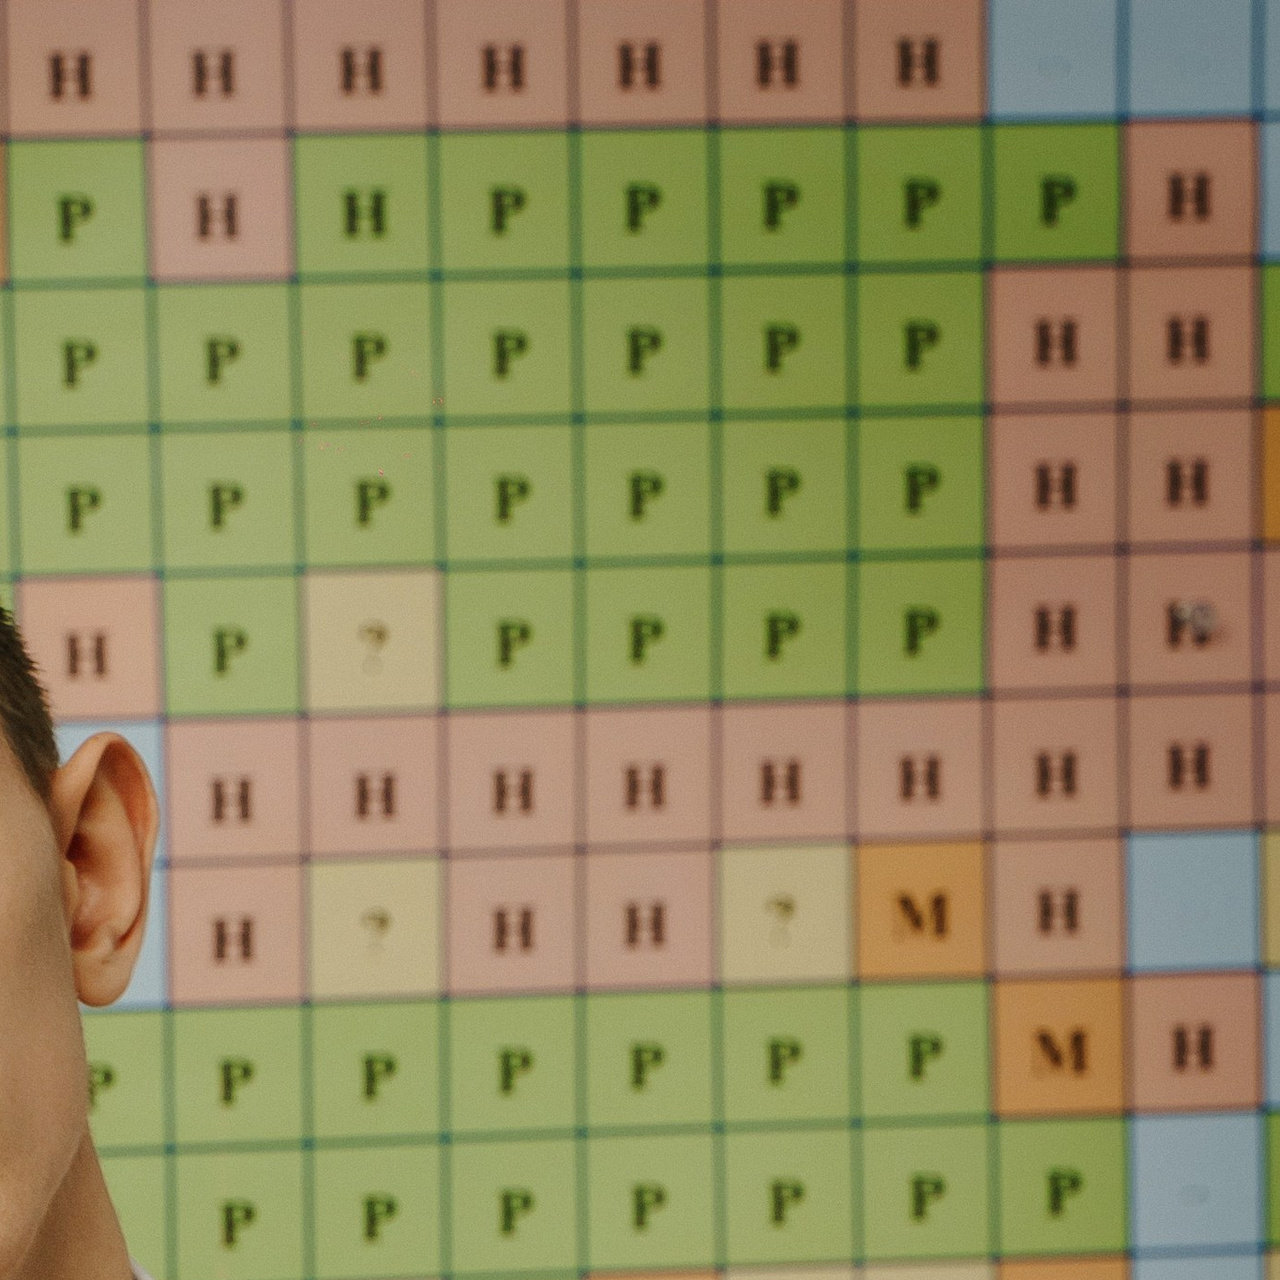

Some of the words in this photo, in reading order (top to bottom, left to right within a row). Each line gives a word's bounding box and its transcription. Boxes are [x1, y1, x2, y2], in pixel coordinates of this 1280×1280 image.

[48, 51, 92, 101] Н
[191, 49, 235, 98] Н
[339, 46, 384, 95] Н
[481, 43, 526, 94] Н
[617, 40, 662, 92] Н
[754, 38, 800, 90] Н
[895, 36, 941, 88] Н
[196, 193, 239, 241] Н
[342, 189, 387, 239] Н
[489, 186, 527, 236] Р
[624, 182, 663, 234] Р
[762, 180, 801, 233] Р
[1039, 175, 1078, 228] Р
[1167, 171, 1212, 223] Н
[62, 340, 98, 388] Р
[205, 338, 241, 385] Р
[492, 330, 529, 379] Р
[626, 326, 664, 376] Р
[764, 323, 801, 374] Р
[1033, 318, 1079, 369] Н
[1165, 314, 1211, 366] Н
[66, 486, 102, 534] Р
[209, 483, 244, 530] Р
[495, 475, 531, 524] Р
[628, 472, 665, 521] Р
[765, 468, 802, 518] Р
[1034, 461, 1078, 512] Н
[1164, 457, 1210, 509] Н
[65, 632, 108, 679] Н
[497, 621, 532, 668] Р
[629, 616, 665, 664] Р
[765, 612, 801, 661] Р
[1033, 603, 1078, 653] Н
[211, 777, 253, 824] Н
[355, 773, 396, 820] Н
[493, 768, 534, 815] Н
[624, 764, 666, 811] Н
[760, 759, 802, 806] Н
[899, 755, 942, 802] Н
[1034, 750, 1078, 799] Н
[1166, 741, 1212, 792] Н
[213, 917, 254, 963] Н
[493, 906, 534, 953] Н
[624, 902, 666, 949] Н
[896, 891, 949, 939] М
[1037, 888, 1080, 935] Н
[219, 1059, 254, 1106] Р
[362, 1054, 397, 1101] Р
[630, 1044, 665, 1090] Р
[767, 1039, 802, 1085] Р
[908, 1034, 944, 1081] Р
[1035, 1028, 1088, 1076] М
[1171, 1023, 1215, 1073] Н
[221, 1201, 256, 1248] Р
[500, 1190, 534, 1236] Р
[632, 1185, 667, 1230] Р
[770, 1180, 805, 1226] Р
[1047, 1169, 1083, 1217] Р
